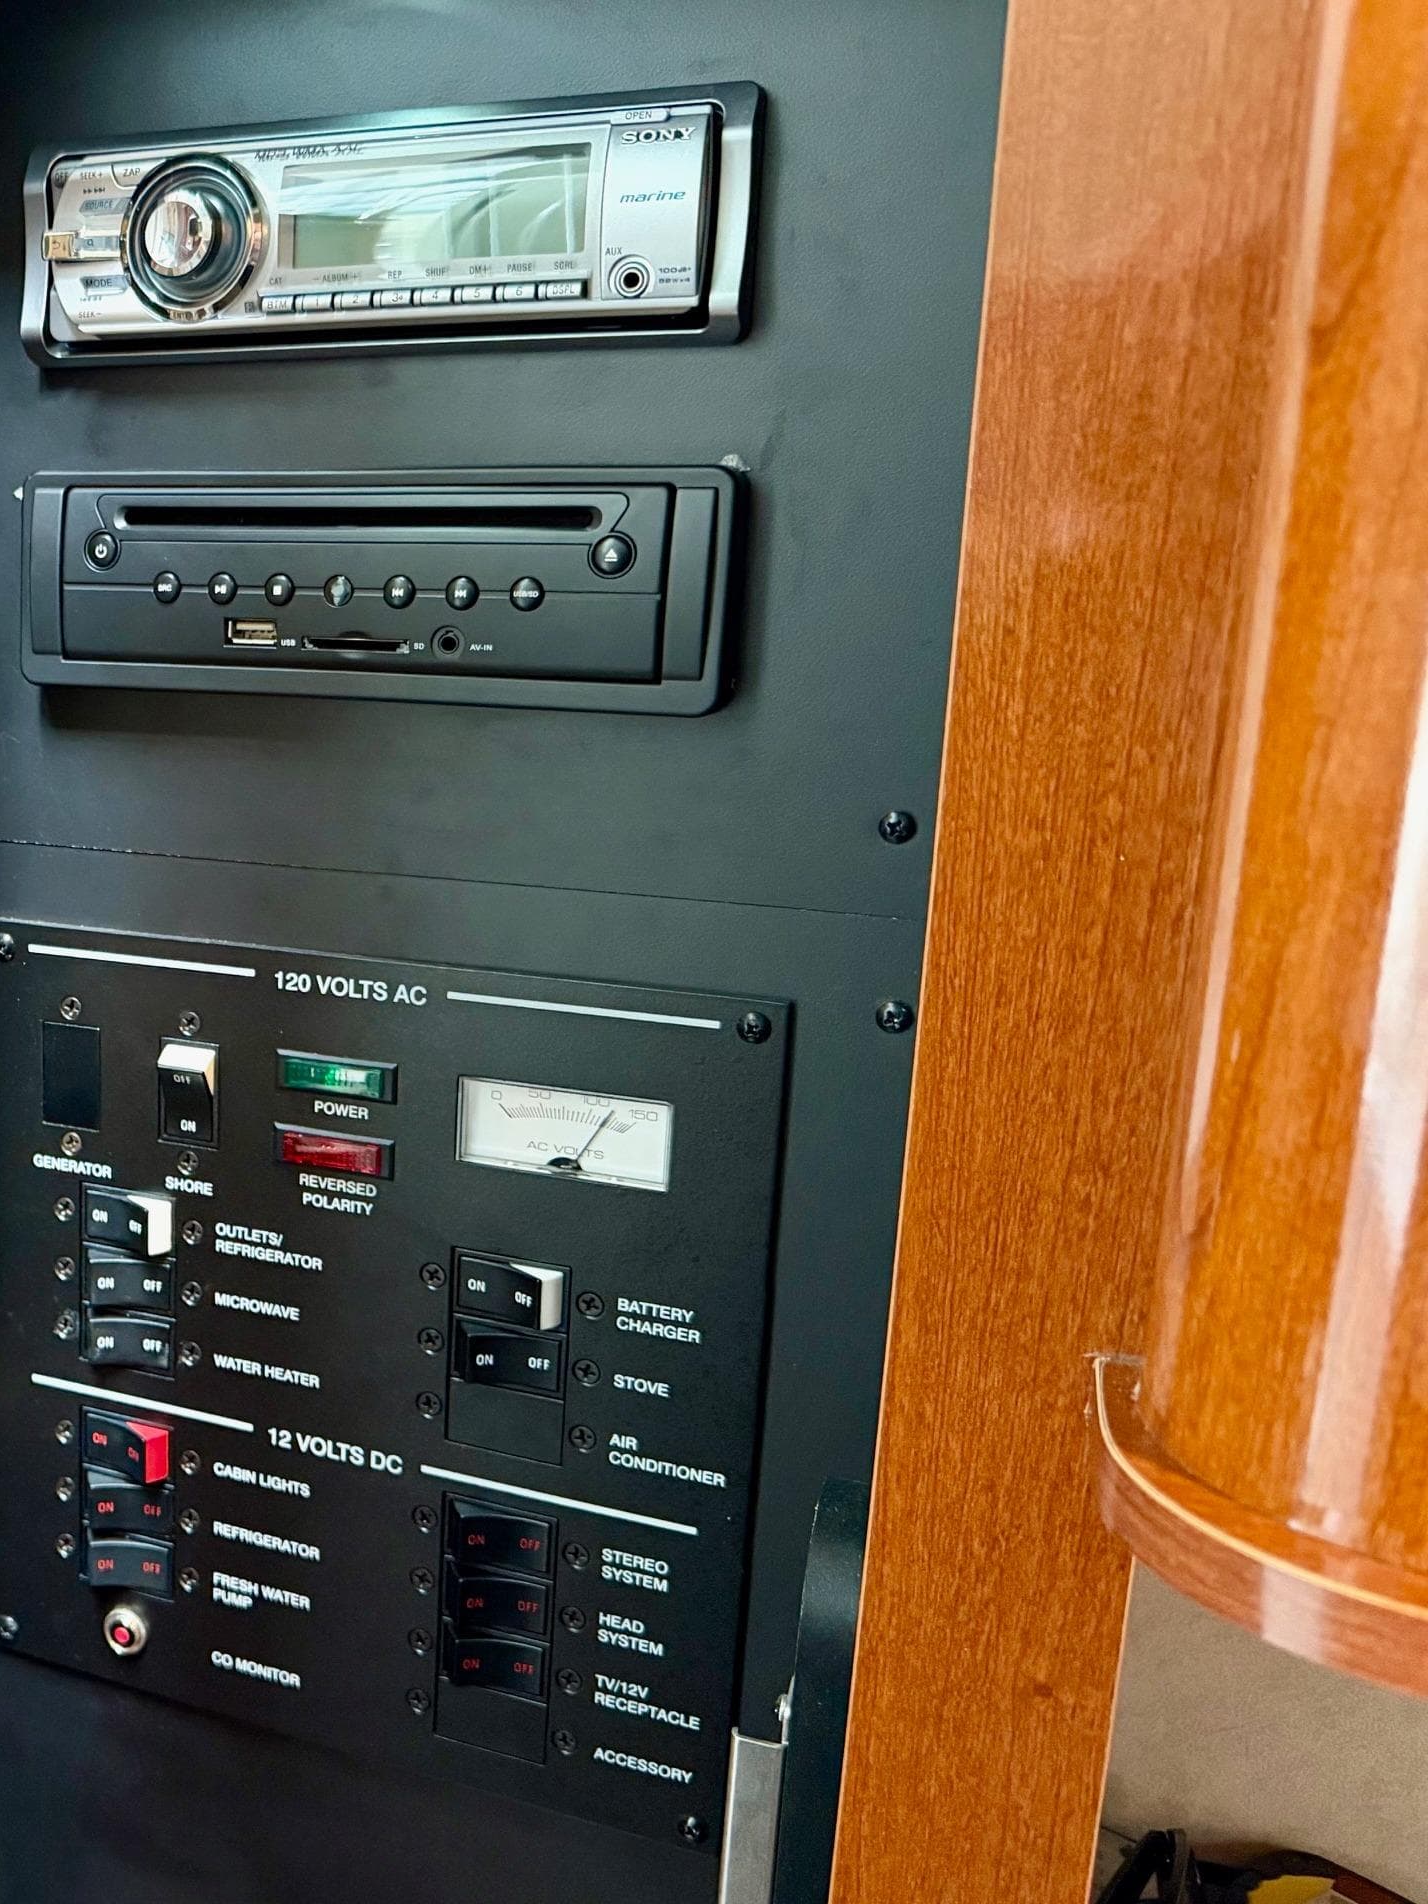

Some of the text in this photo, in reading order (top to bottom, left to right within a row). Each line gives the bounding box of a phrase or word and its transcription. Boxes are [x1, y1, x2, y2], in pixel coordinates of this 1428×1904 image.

[625, 111, 652, 120] OPEN
[622, 127, 696, 145] SONY
[122, 167, 141, 178] ZAP
[620, 190, 686, 203] marine
[605, 247, 622, 256] AUX
[85, 278, 113, 288] MODE
[414, 642, 425, 650] SD
[274, 971, 427, 1006] 120 VOLTS AC
[314, 1100, 368, 1120] POWER
[490, 1089, 658, 1122] 0 50 100 150
[180, 1119, 196, 1132] ON
[527, 1141, 548, 1151] AC
[33, 1154, 112, 1179] GENERATOR
[165, 1176, 213, 1196] SHORE
[299, 1173, 377, 1197] REVERSED
[302, 1192, 373, 1215] POLARITY
[92, 1209, 108, 1223] ON
[215, 1222, 283, 1247] OUTLETS/
[215, 1239, 323, 1271] REFRIGERATOR
[97, 1277, 162, 1292] ON OFF
[468, 1278, 485, 1292] ON
[214, 1292, 300, 1321] MICROWAVE
[515, 1291, 532, 1307] OFF
[618, 1298, 694, 1323] BATTERY
[616, 1316, 700, 1343] CHARGER
[96, 1336, 162, 1352] ON OFF
[214, 1354, 319, 1388] WATER HEATER
[476, 1354, 550, 1370] ON OFF
[613, 1374, 669, 1397] STOVE
[92, 1432, 107, 1445] ON
[609, 1434, 637, 1450] AIR
[268, 1427, 403, 1475] 12 VOLTS DC
[213, 1462, 310, 1497] CABIN LIGHTS
[609, 1451, 725, 1487] CONDITIONER
[213, 1521, 320, 1560] REFRIGERATOR
[602, 1548, 669, 1575] STEREO
[601, 1565, 668, 1592] SYSTEM
[213, 1572, 310, 1609] FRESH WATER
[213, 1588, 253, 1608] PUMP
[599, 1612, 644, 1634] HEAD
[598, 1629, 663, 1656] SYSTEM
[212, 1651, 300, 1686] CO MONITOR
[595, 1674, 648, 1698] TV/12V
[594, 1691, 700, 1730] RECEPTACLE
[594, 1748, 692, 1783] ACCESSORY
